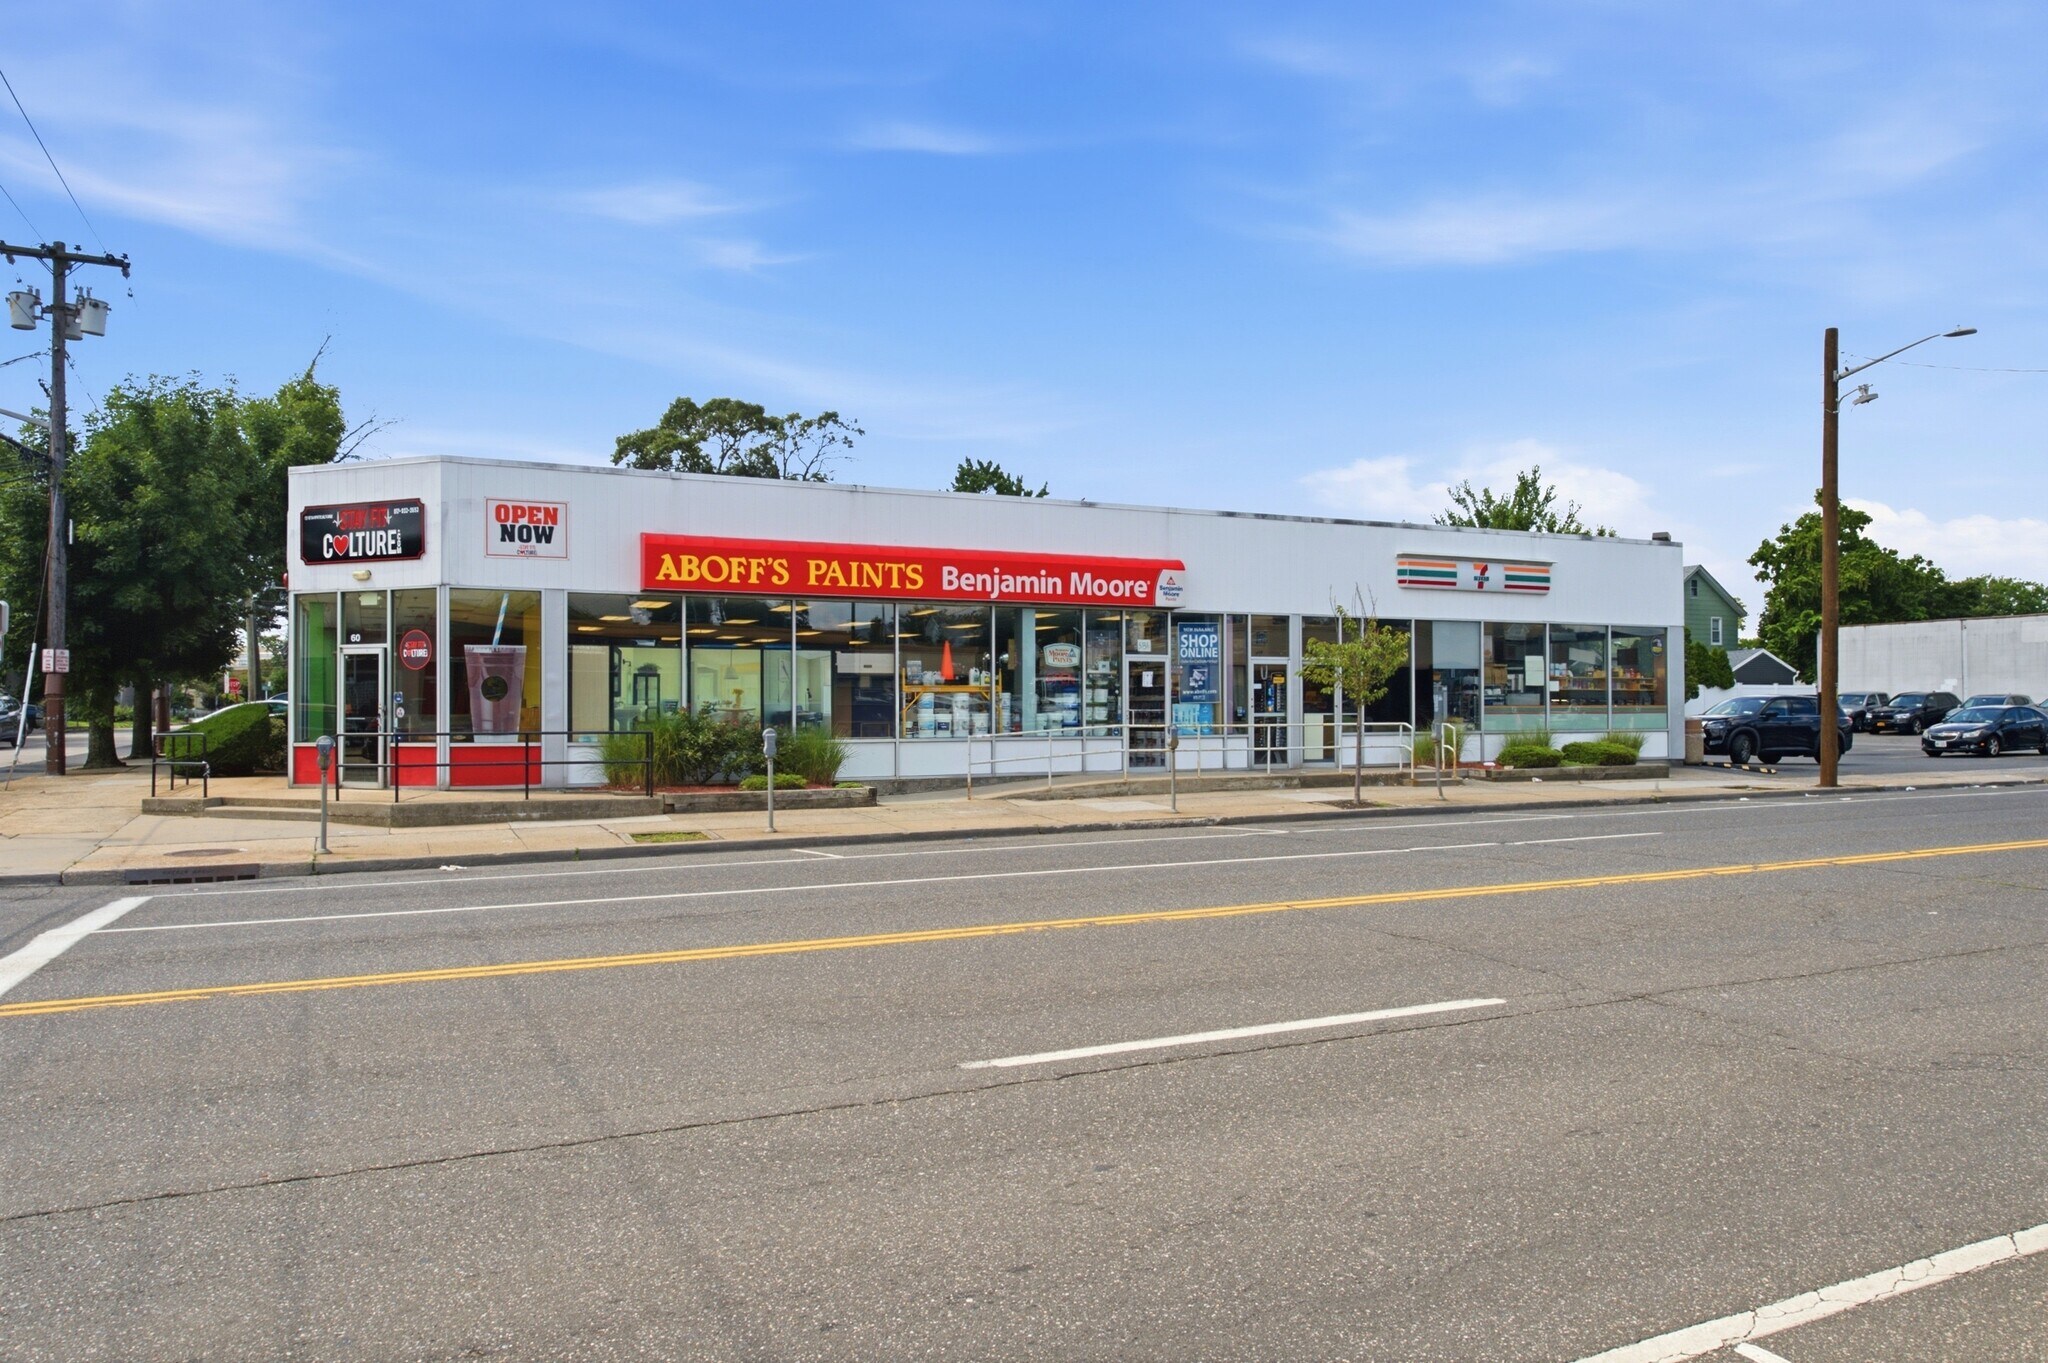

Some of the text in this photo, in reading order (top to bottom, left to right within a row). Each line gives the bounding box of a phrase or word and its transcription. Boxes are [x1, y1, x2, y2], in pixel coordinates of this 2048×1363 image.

[340, 506, 388, 530] STAY FIT
[495, 504, 558, 525] OPEN
[323, 529, 397, 558] CLTURE
[500, 524, 554, 544] NOW
[655, 553, 1147, 599] ABOFF'S PAINTS Benjamin Moore
[350, 633, 361, 642] 60
[1180, 634, 1218, 648] SHOP
[1180, 647, 1218, 658] ONLINE
